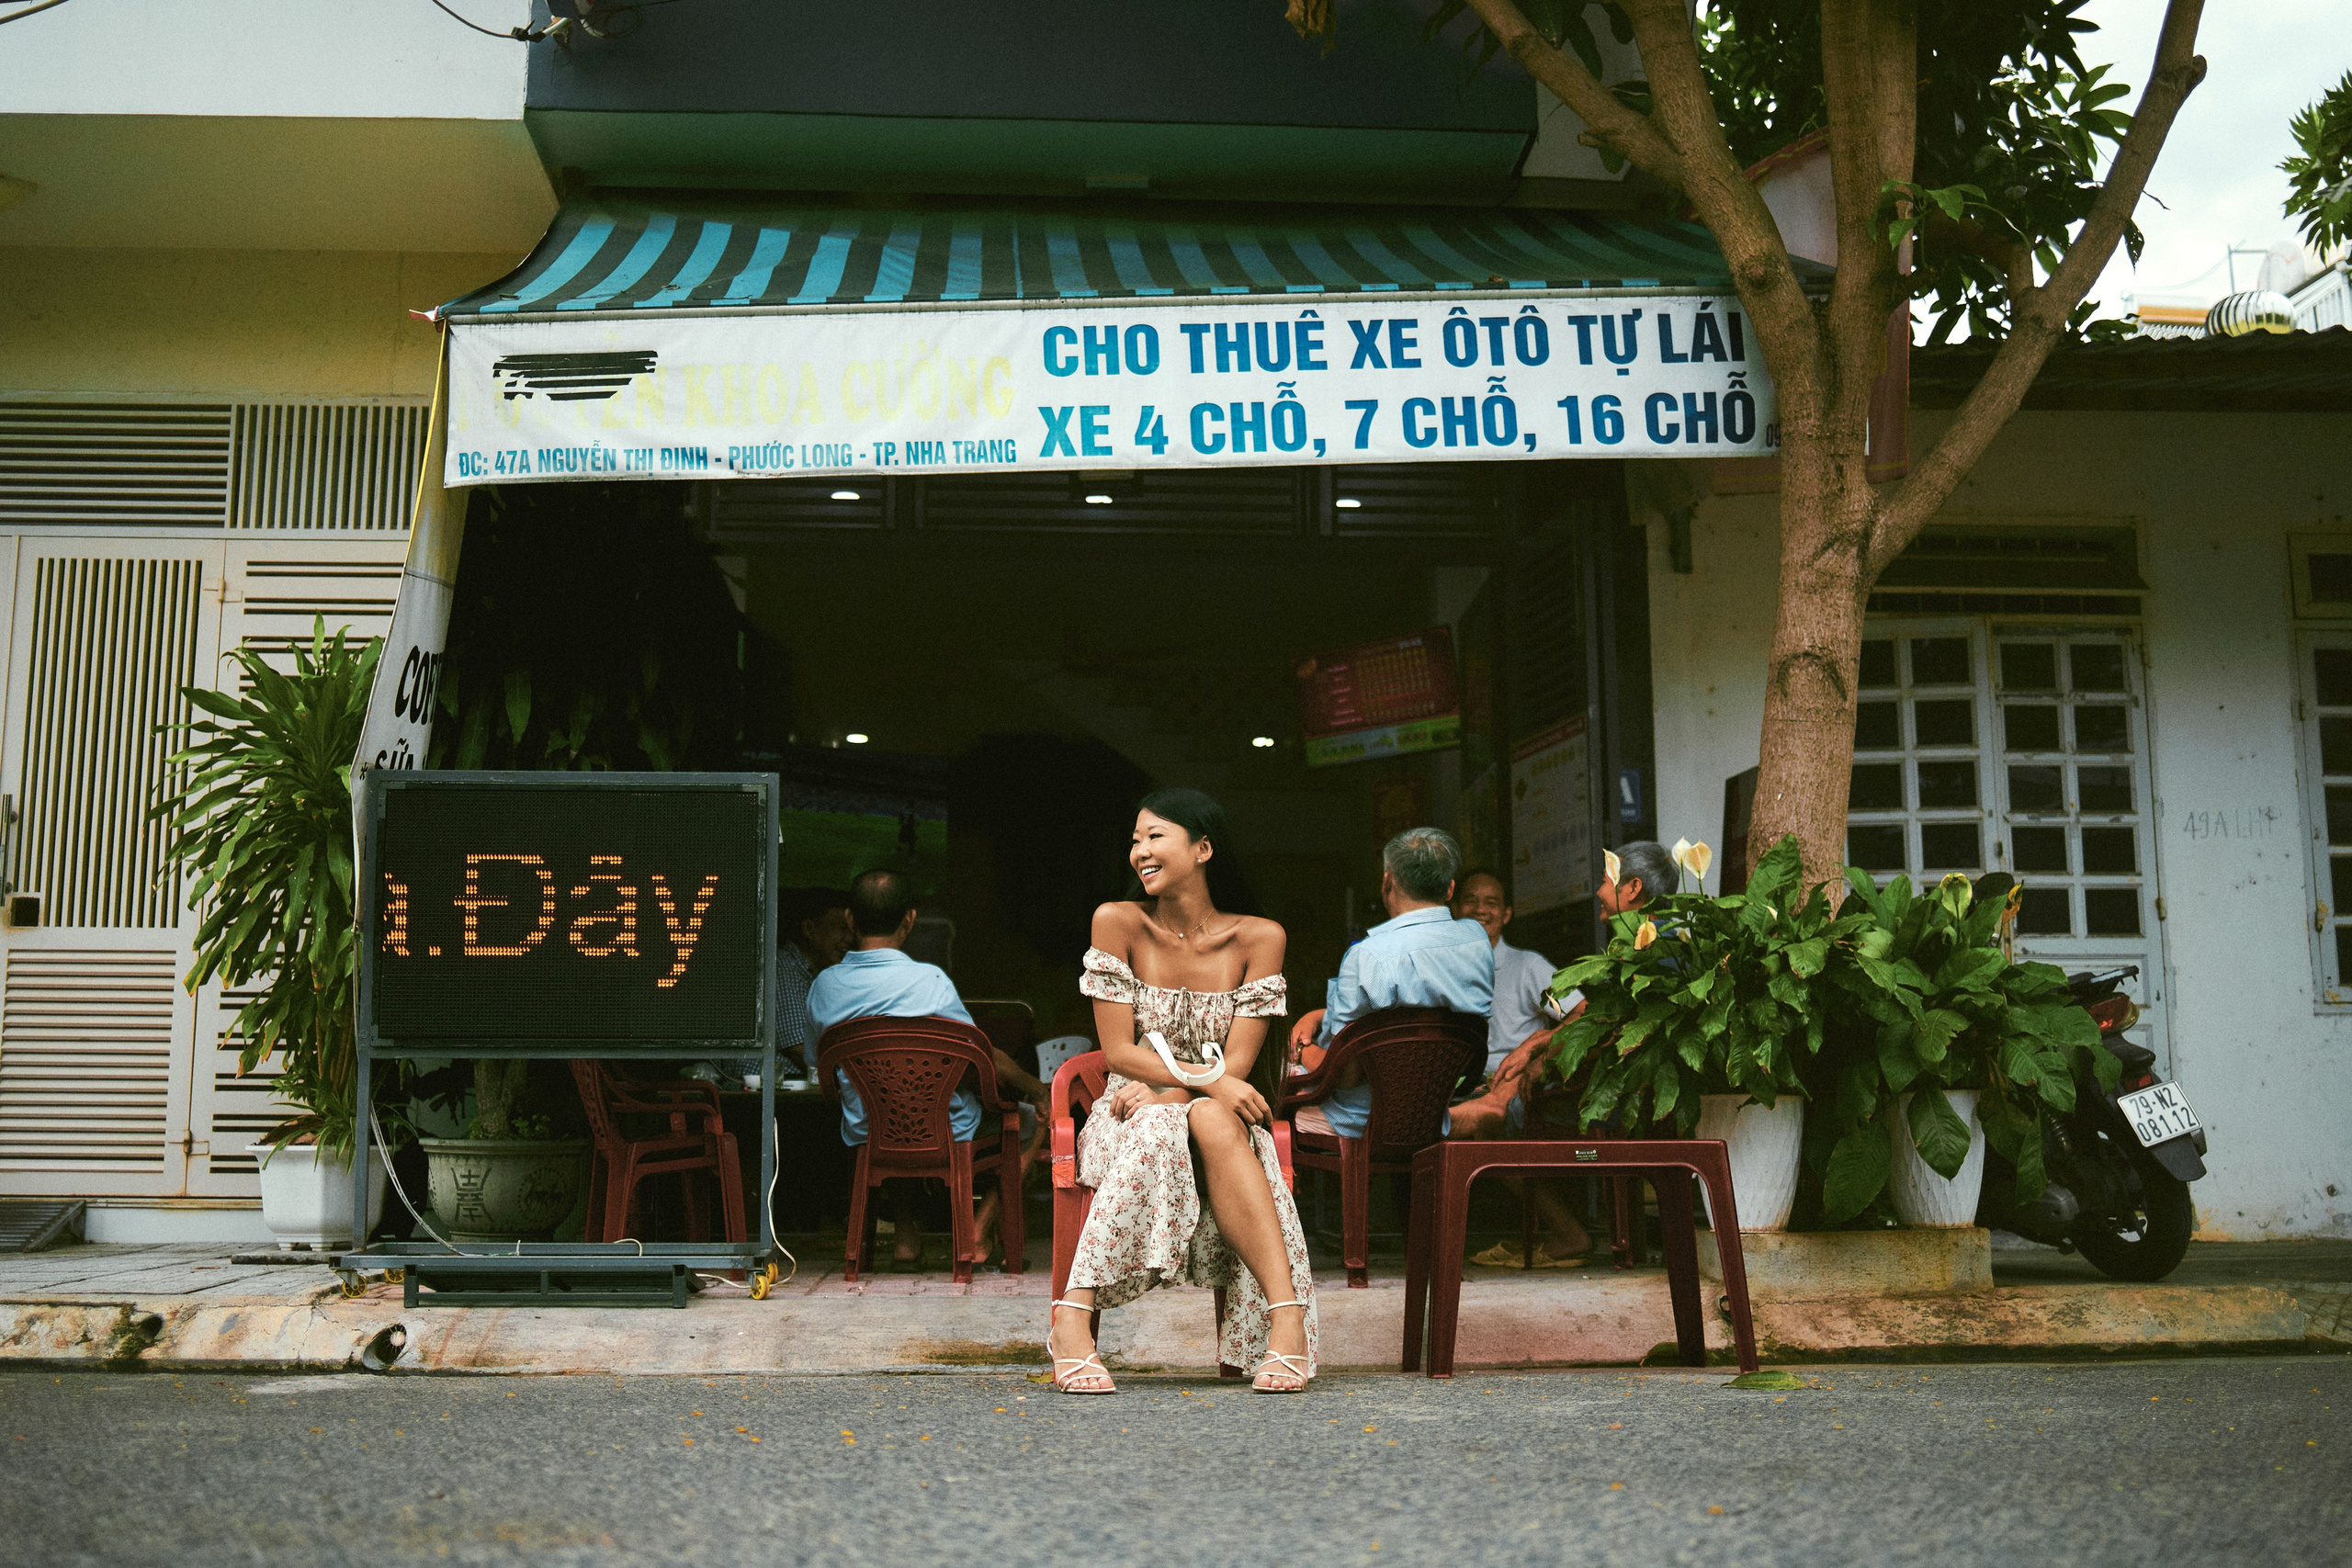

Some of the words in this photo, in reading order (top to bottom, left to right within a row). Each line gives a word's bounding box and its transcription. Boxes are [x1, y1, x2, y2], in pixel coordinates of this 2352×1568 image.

[1043, 323, 1159, 378] CHO
[1180, 309, 1328, 374] THUÊ
[1347, 318, 1421, 369] XE
[1442, 304, 1550, 368] ÔTÔ
[1567, 308, 1643, 377] TỰ
[1657, 300, 1746, 364] LÁI
[683, 361, 825, 427] KHOA
[1037, 404, 1114, 458] XE
[1134, 404, 1169, 456] 4
[1189, 380, 1327, 458] CHỖ,
[1344, 399, 1379, 450] 7
[1401, 376, 1537, 453] CHỖ,
[1556, 394, 1625, 446] 16
[1644, 370, 1757, 445] CHỖ
[458, 451, 488, 477] ĐC:
[494, 449, 531, 475] 47A
[537, 439, 616, 473] NGUYỄN
[623, 448, 653, 477] THỊ
[661, 446, 708, 477] ĐỊNH
[728, 440, 795, 471] PHƯỚC
[801, 443, 853, 468] LONG
[873, 441, 899, 467] TP.
[905, 440, 946, 466] NHA
[953, 438, 1017, 465] TRANG
[2136, 1107, 2197, 1143] 081.12
